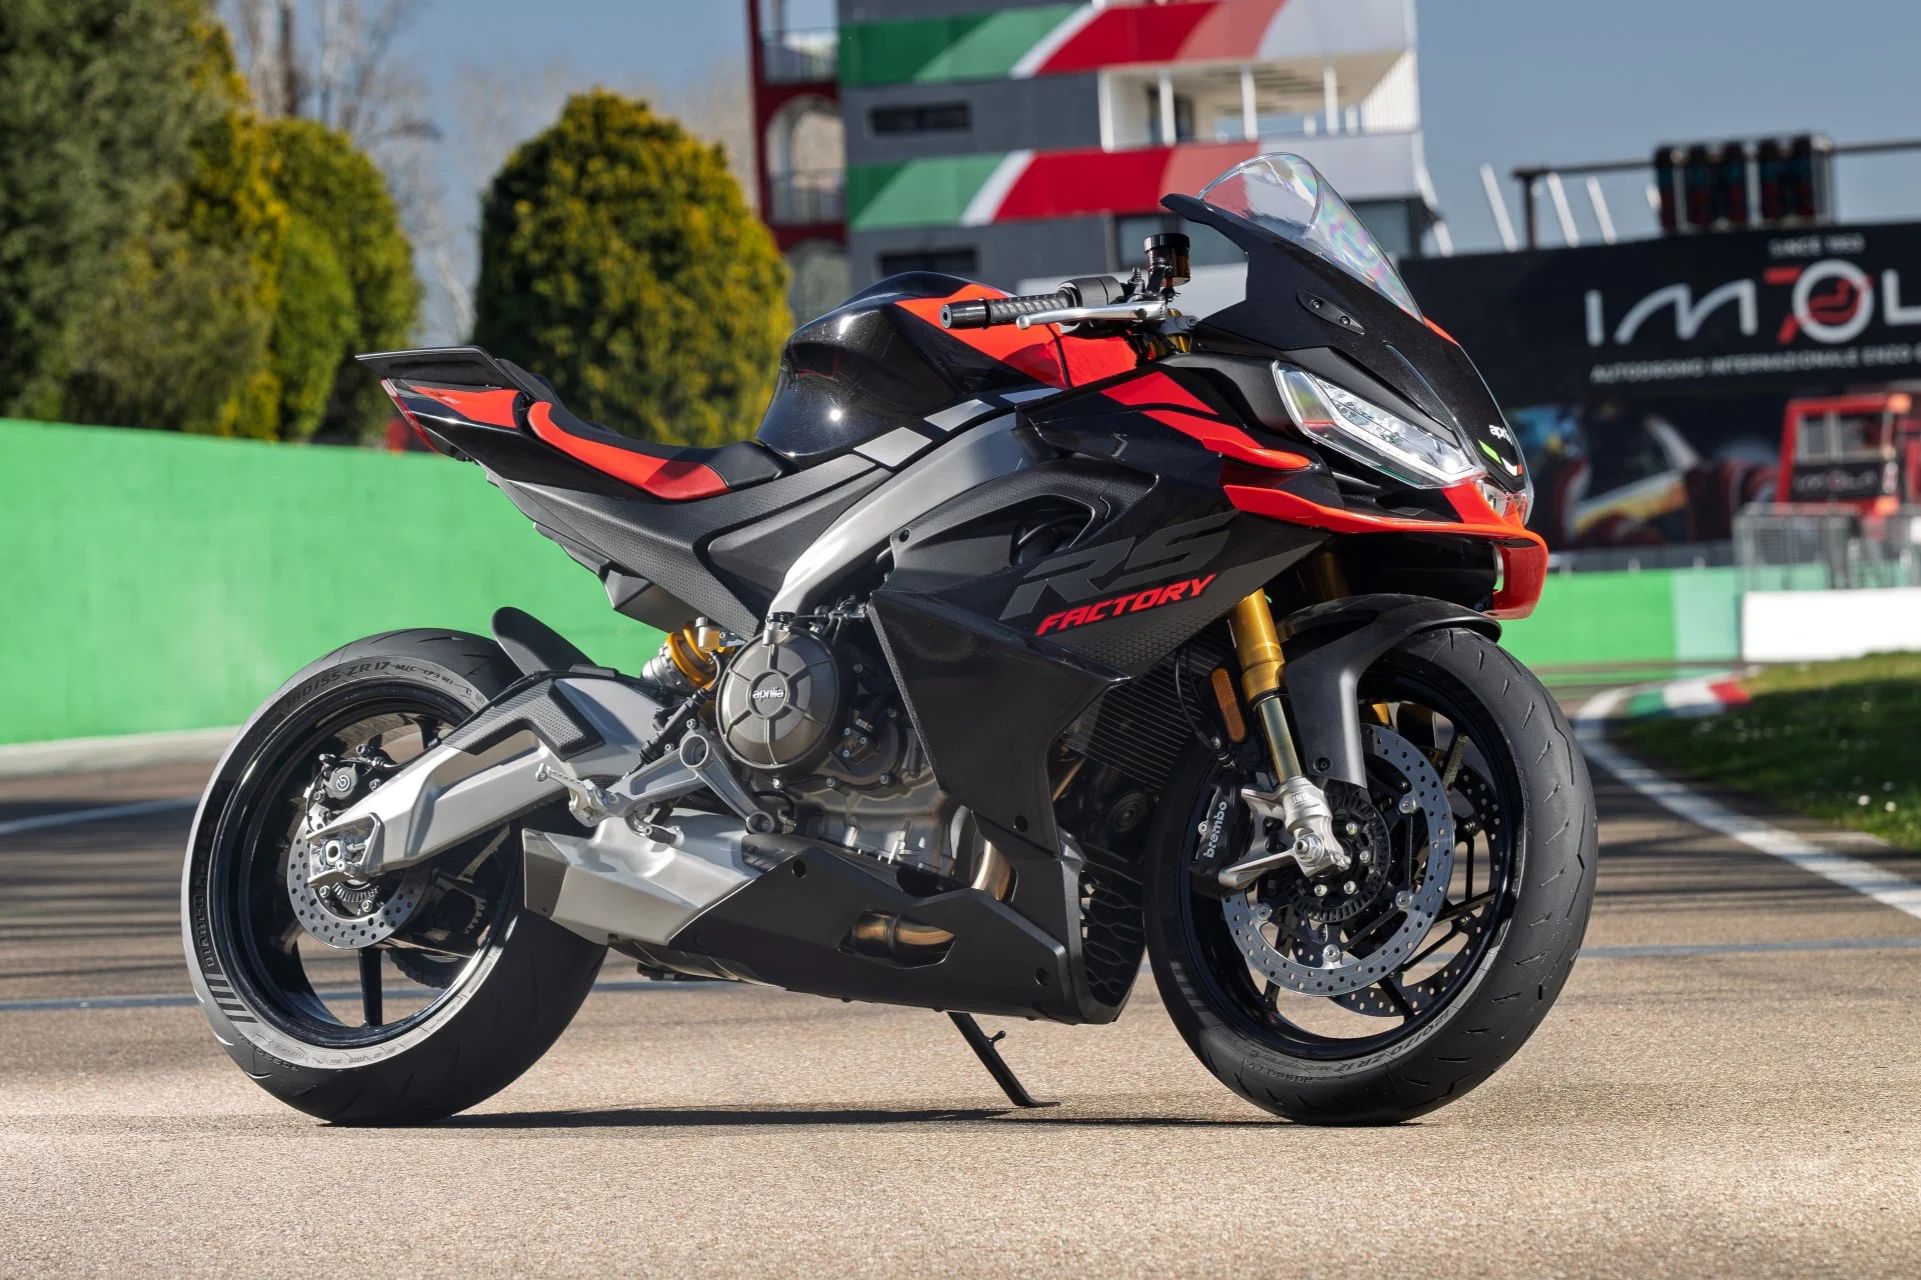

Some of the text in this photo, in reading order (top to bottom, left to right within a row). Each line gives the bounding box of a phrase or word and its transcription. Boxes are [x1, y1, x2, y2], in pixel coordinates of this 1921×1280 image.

[999, 508, 1241, 621] RS
[1035, 573, 1217, 637] FACTORY
[375, 660, 392, 671] 17
[1203, 801, 1227, 858] brembo
